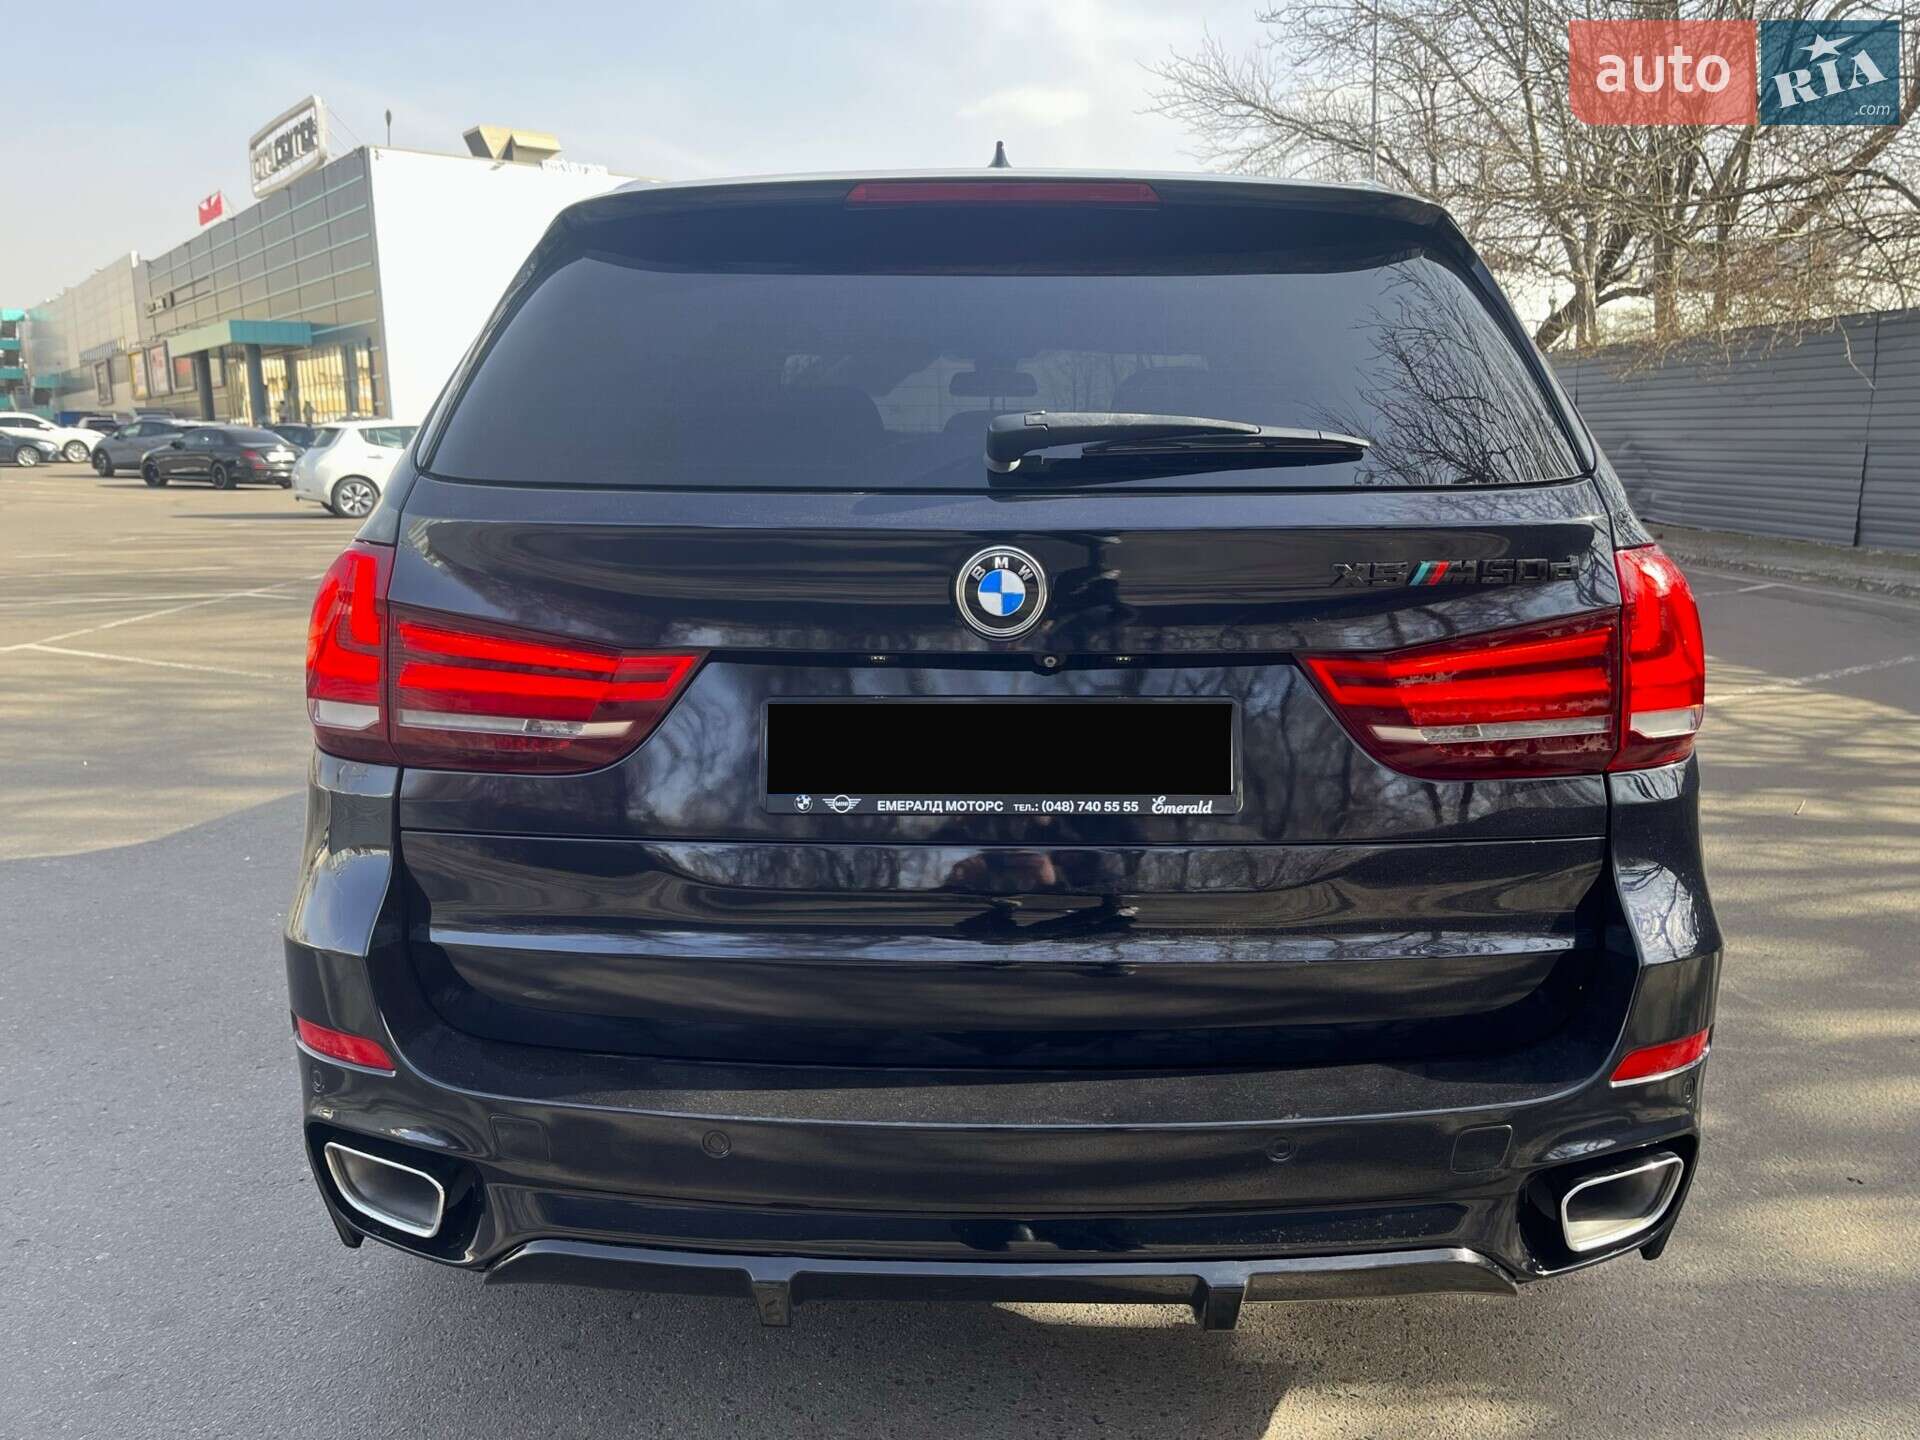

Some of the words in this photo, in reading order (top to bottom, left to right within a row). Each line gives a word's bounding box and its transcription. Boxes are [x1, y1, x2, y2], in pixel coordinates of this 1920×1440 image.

[970, 556, 1034, 581] BMW
[1331, 560, 1408, 587] X5
[877, 800, 943, 813] ЕМЕРАЛД
[945, 800, 1004, 812] МОТОРС
[1041, 800, 1074, 813] (048)
[1077, 801, 1100, 812] 740
[1104, 801, 1119, 812] 55
[1122, 801, 1139, 812] 55
[1152, 795, 1213, 814] Emerald
